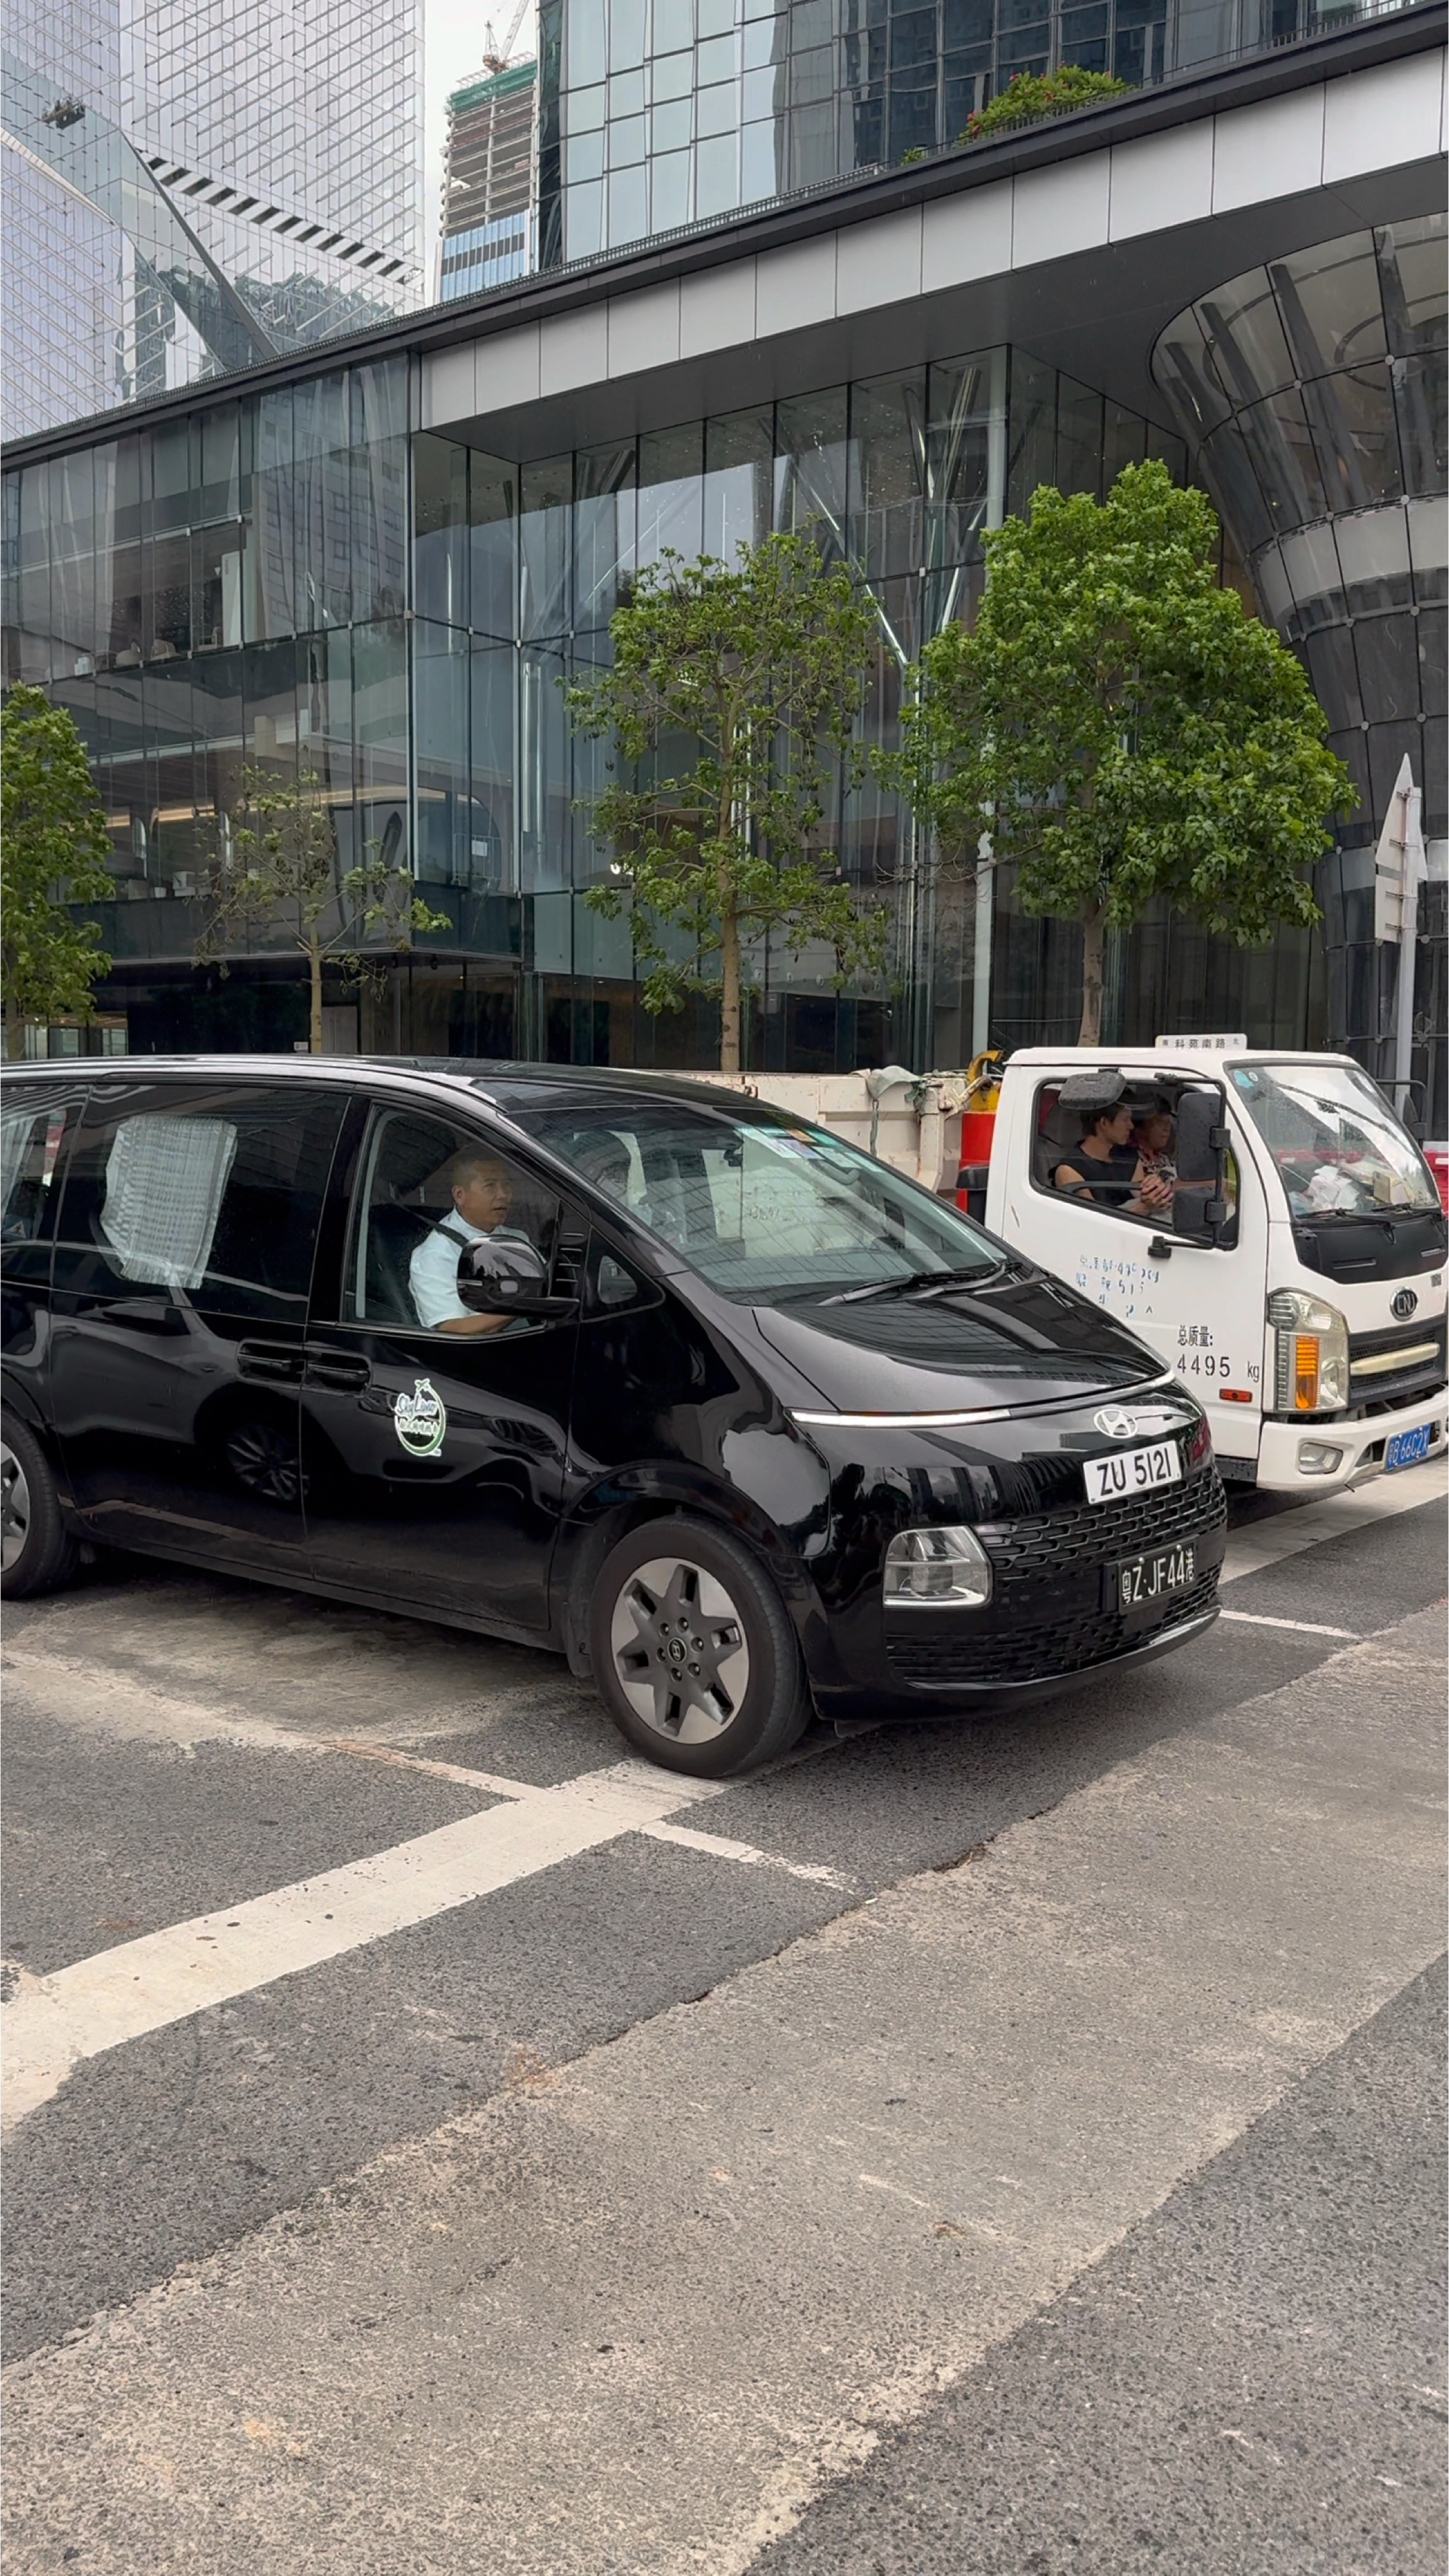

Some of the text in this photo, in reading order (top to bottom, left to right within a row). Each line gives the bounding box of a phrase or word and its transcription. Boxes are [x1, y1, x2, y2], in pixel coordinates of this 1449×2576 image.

[1175, 1038, 1225, 1049] 科苑南路
[1177, 1325, 1213, 1347] 总质量:
[1177, 1354, 1259, 1383] 4495 kg
[1097, 1448, 1171, 1496] ZU 5121
